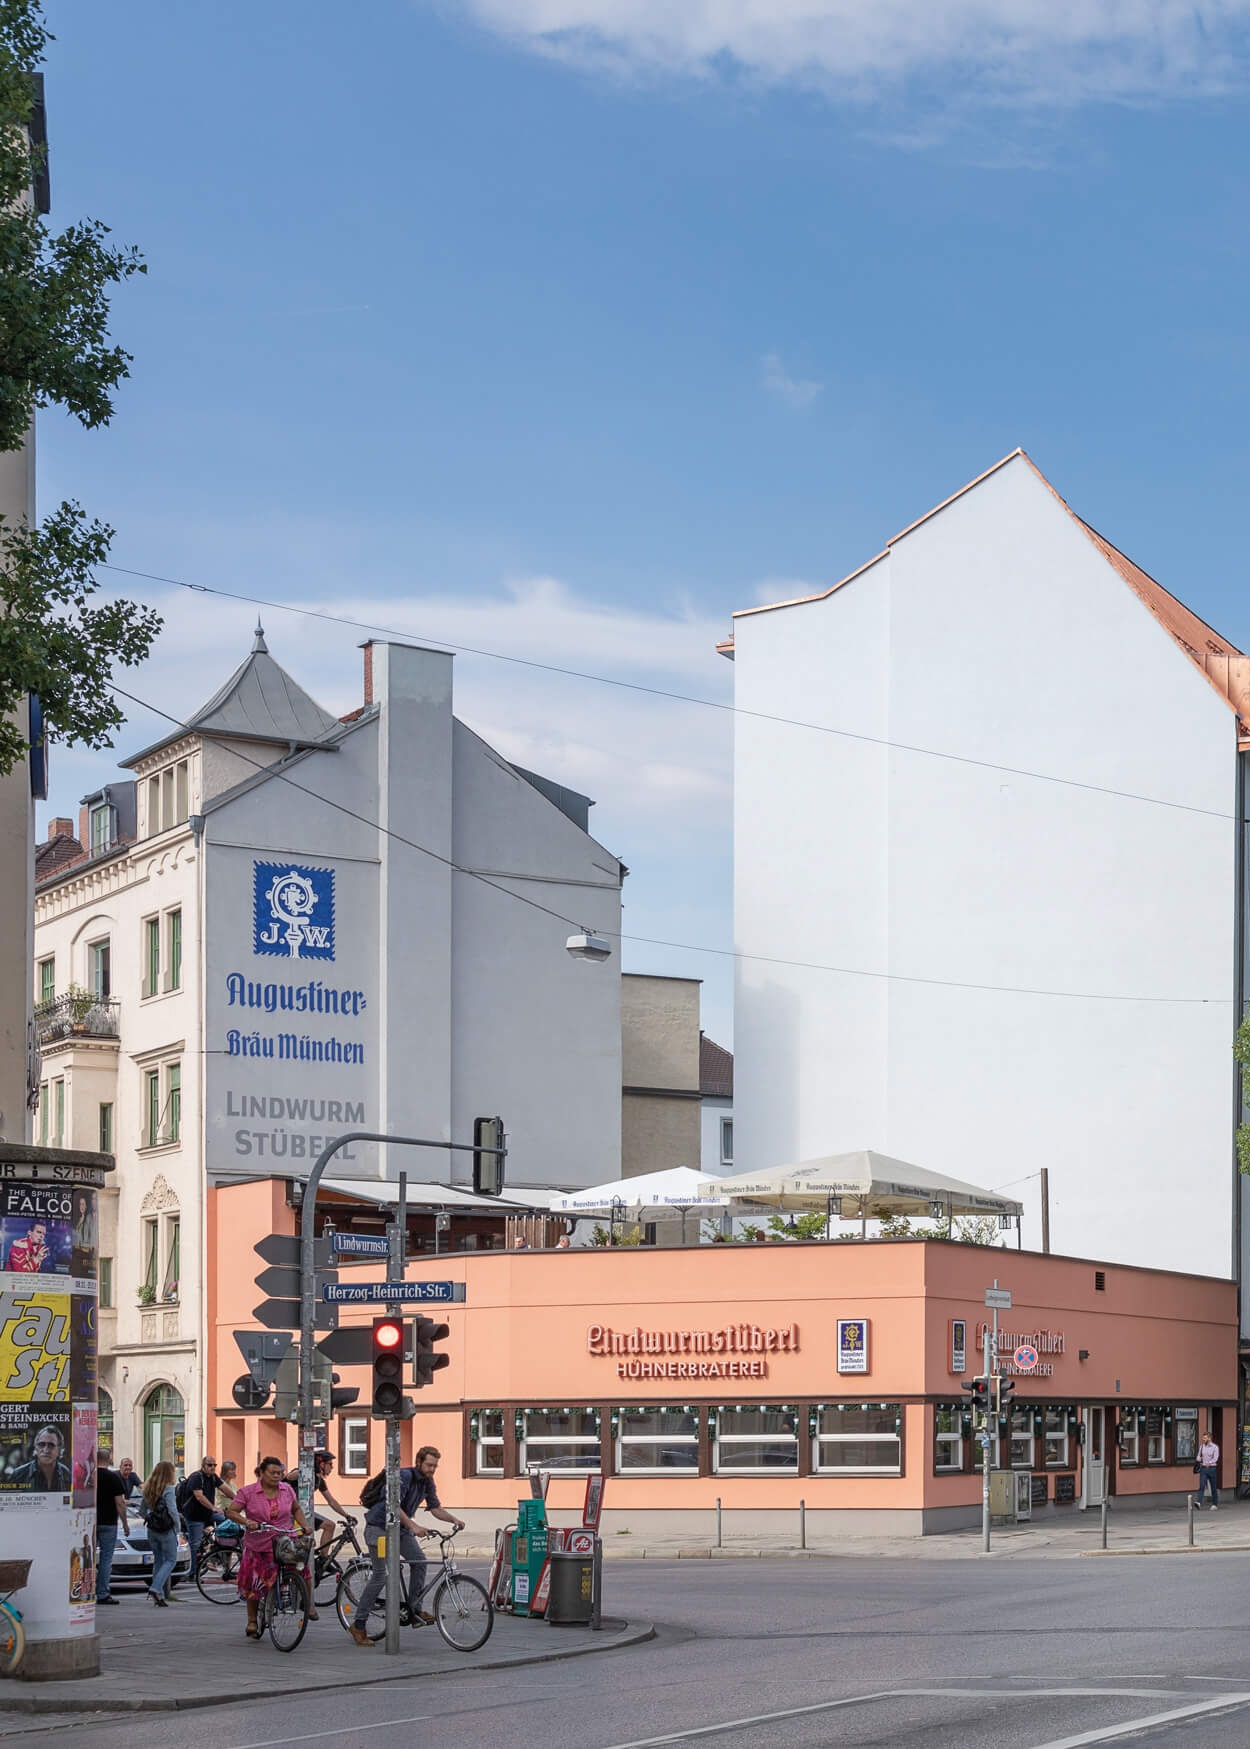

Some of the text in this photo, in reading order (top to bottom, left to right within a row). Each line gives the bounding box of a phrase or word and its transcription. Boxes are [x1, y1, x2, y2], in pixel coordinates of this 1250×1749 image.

[226, 1029, 364, 1064] Bräu München
[226, 1091, 366, 1124] LINDWURM
[234, 1128, 357, 1160] STÜBERL
[9, 1189, 26, 1197] THE
[7, 1196, 72, 1214] FALCO
[337, 1235, 389, 1253] Lindwurmstr.
[327, 1283, 447, 1301] Herzog-Heinrich-Str.
[587, 1324, 798, 1354] Lindwurmstüberl
[616, 1360, 767, 1378] HÜHNERBRATEREI
[0, 1404, 30, 1413] GERT
